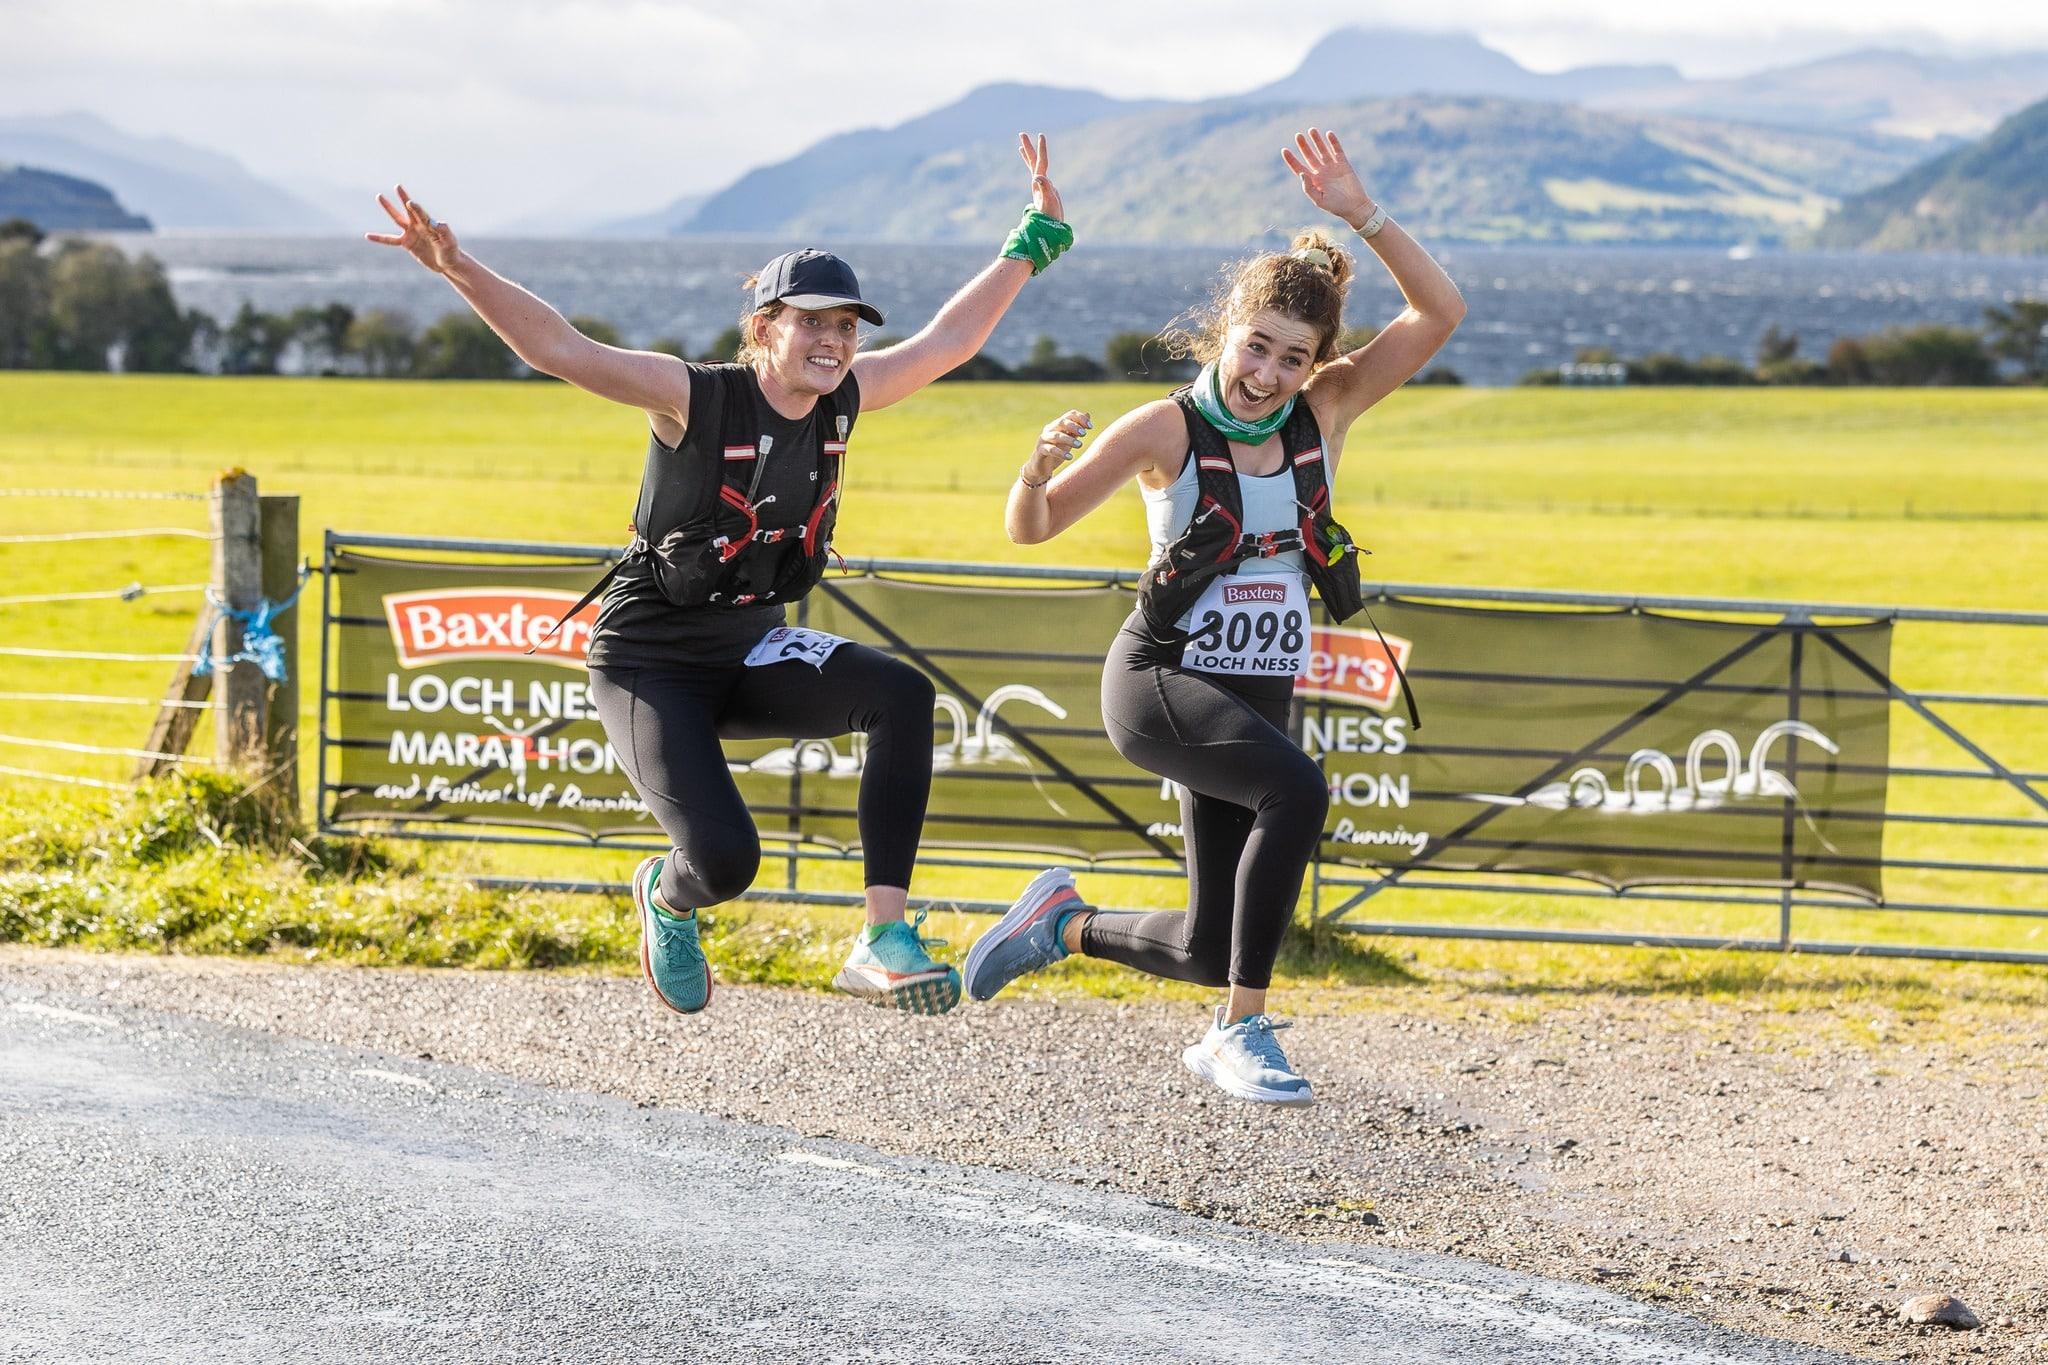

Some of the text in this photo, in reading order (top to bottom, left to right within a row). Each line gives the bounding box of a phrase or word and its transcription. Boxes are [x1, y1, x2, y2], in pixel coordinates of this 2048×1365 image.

[1227, 586, 1284, 602] Baxters
[1197, 610, 1304, 653] 3098
[1193, 655, 1300, 671] LOCH NESS
[387, 672, 514, 716] LOCH
[1302, 715, 1407, 755] NESS
[374, 773, 651, 822] and Festival of Running
[1332, 817, 1430, 856] Running
